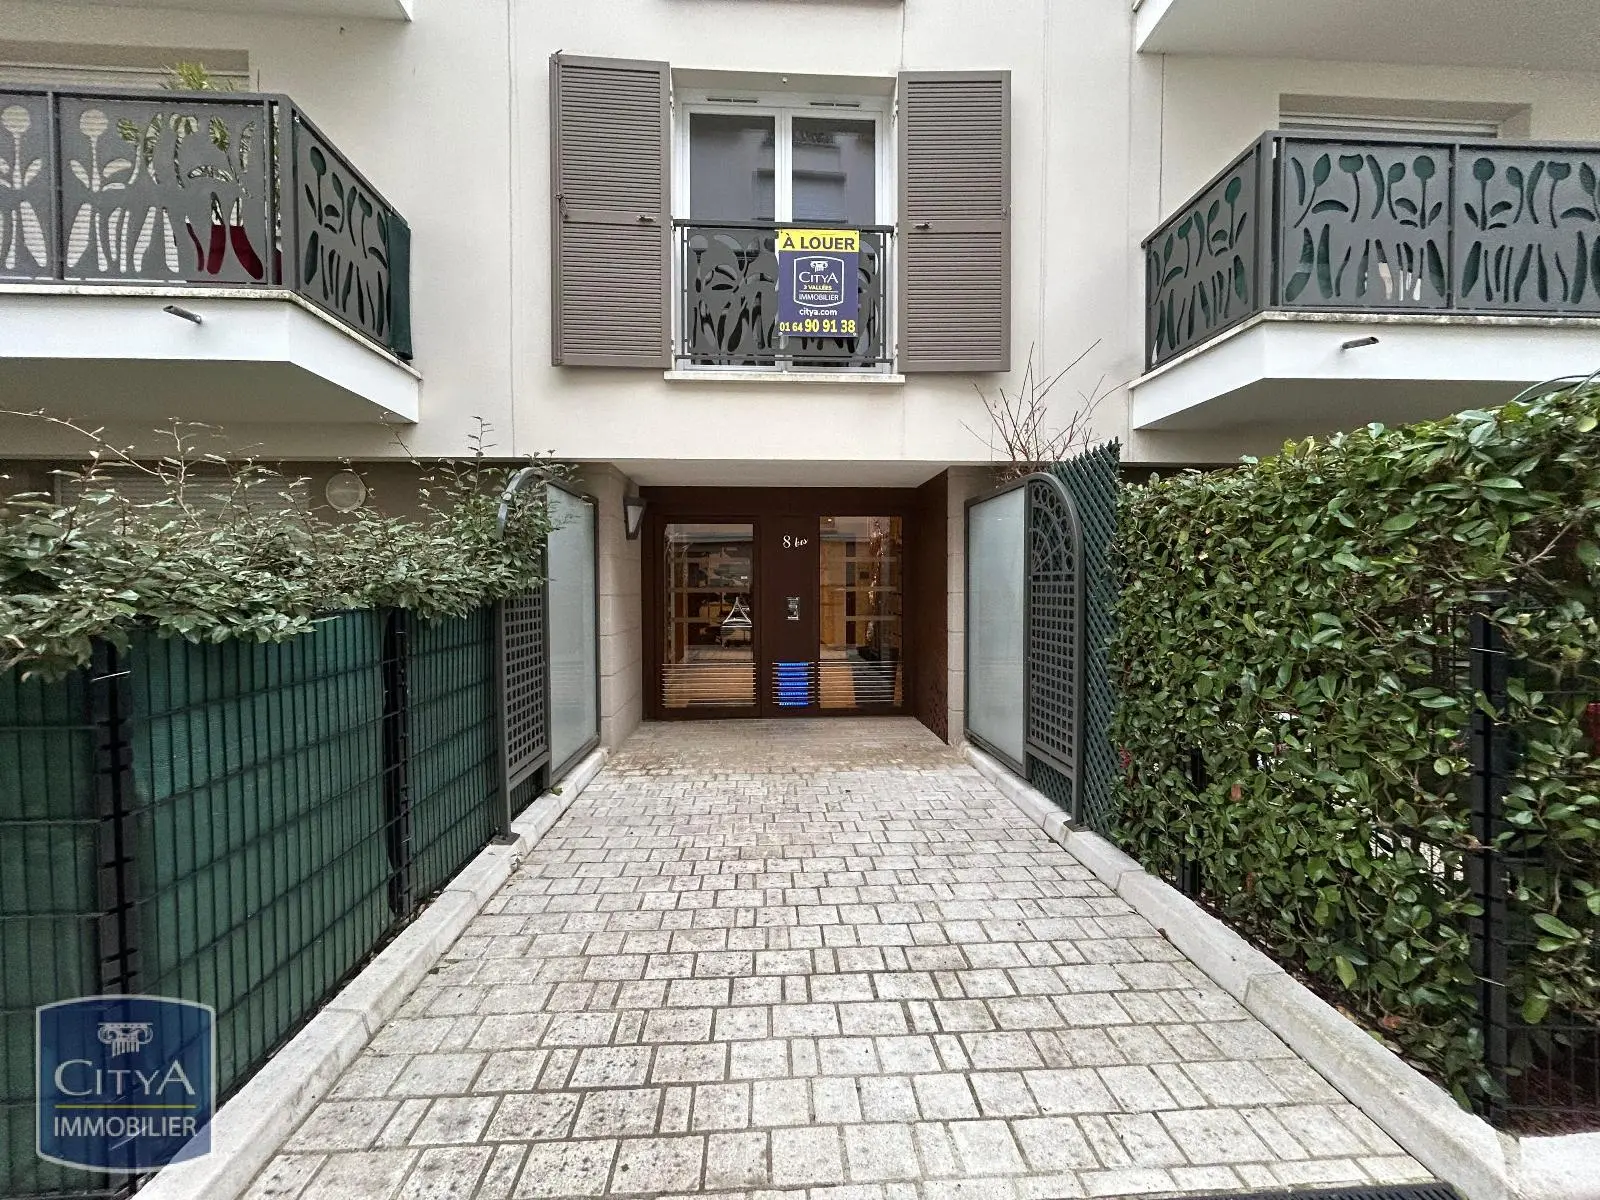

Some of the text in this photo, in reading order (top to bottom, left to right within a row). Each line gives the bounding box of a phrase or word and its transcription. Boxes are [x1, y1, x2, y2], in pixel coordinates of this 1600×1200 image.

[782, 232, 855, 250] À LOUER
[798, 293, 839, 301] IMMOBILIER
[799, 307, 838, 317] citya.com
[779, 318, 856, 333] 01 64 90 91 38
[782, 534, 791, 549] 8
